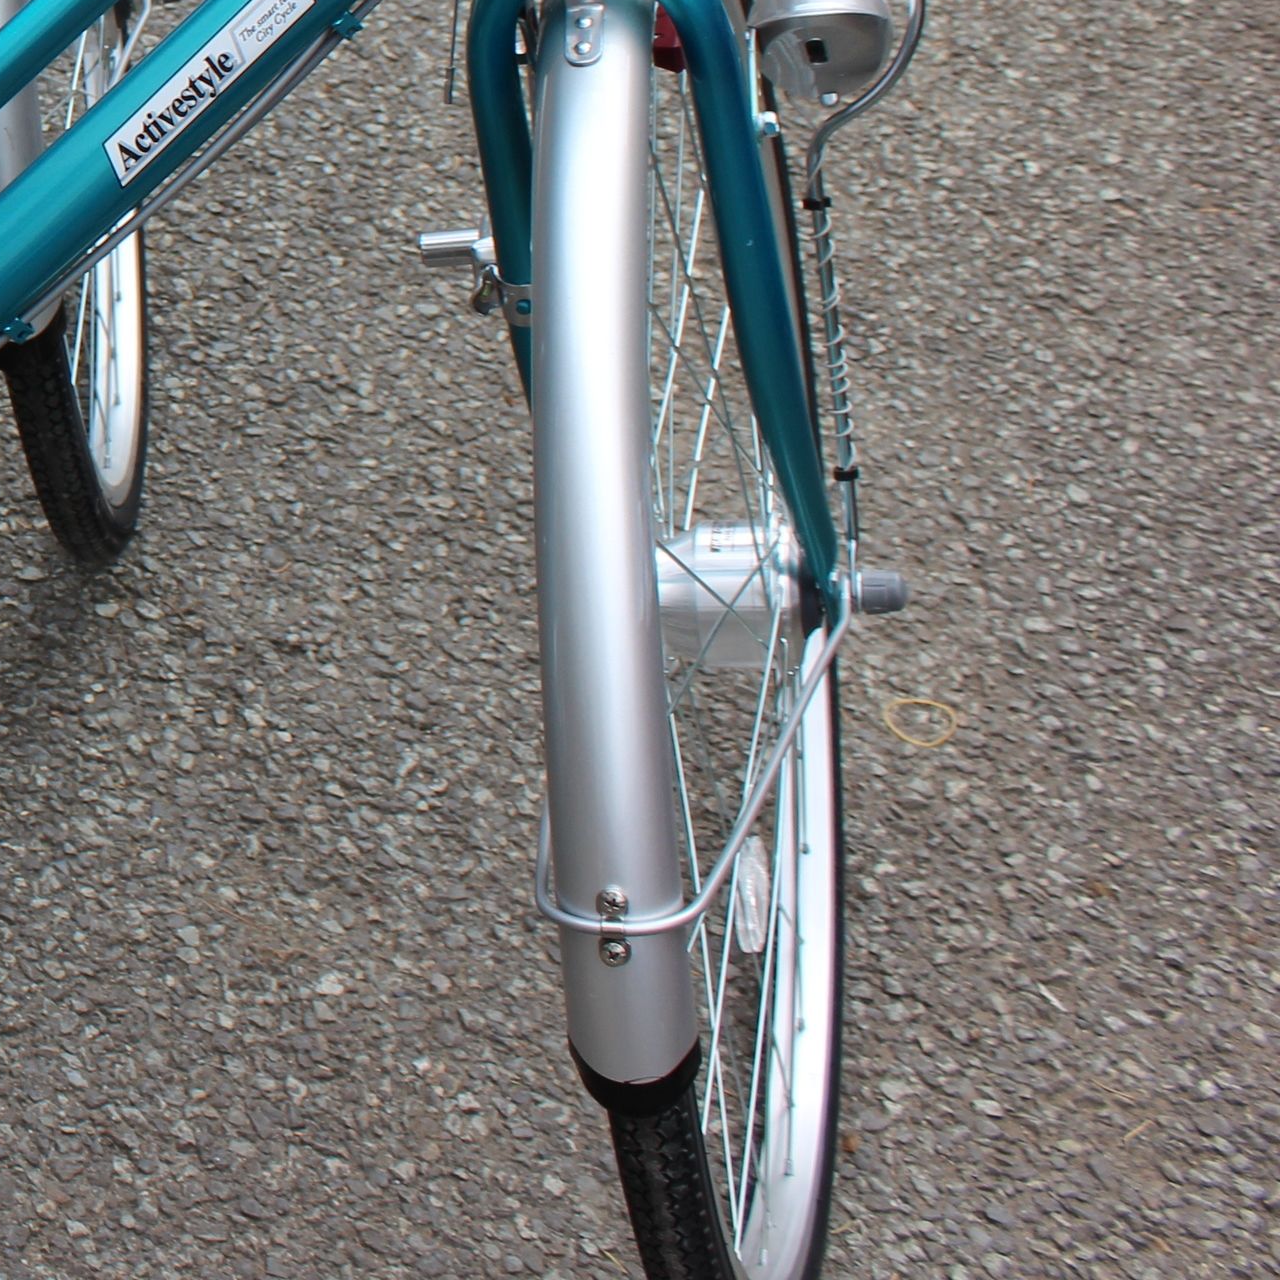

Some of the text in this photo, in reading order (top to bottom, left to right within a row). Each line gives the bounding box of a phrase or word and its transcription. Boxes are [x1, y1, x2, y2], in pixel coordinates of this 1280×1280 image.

[239, 24, 256, 42] The
[256, 2, 279, 26] smart
[256, 1, 298, 43] City Cycle
[116, 50, 236, 173] Activestyle
